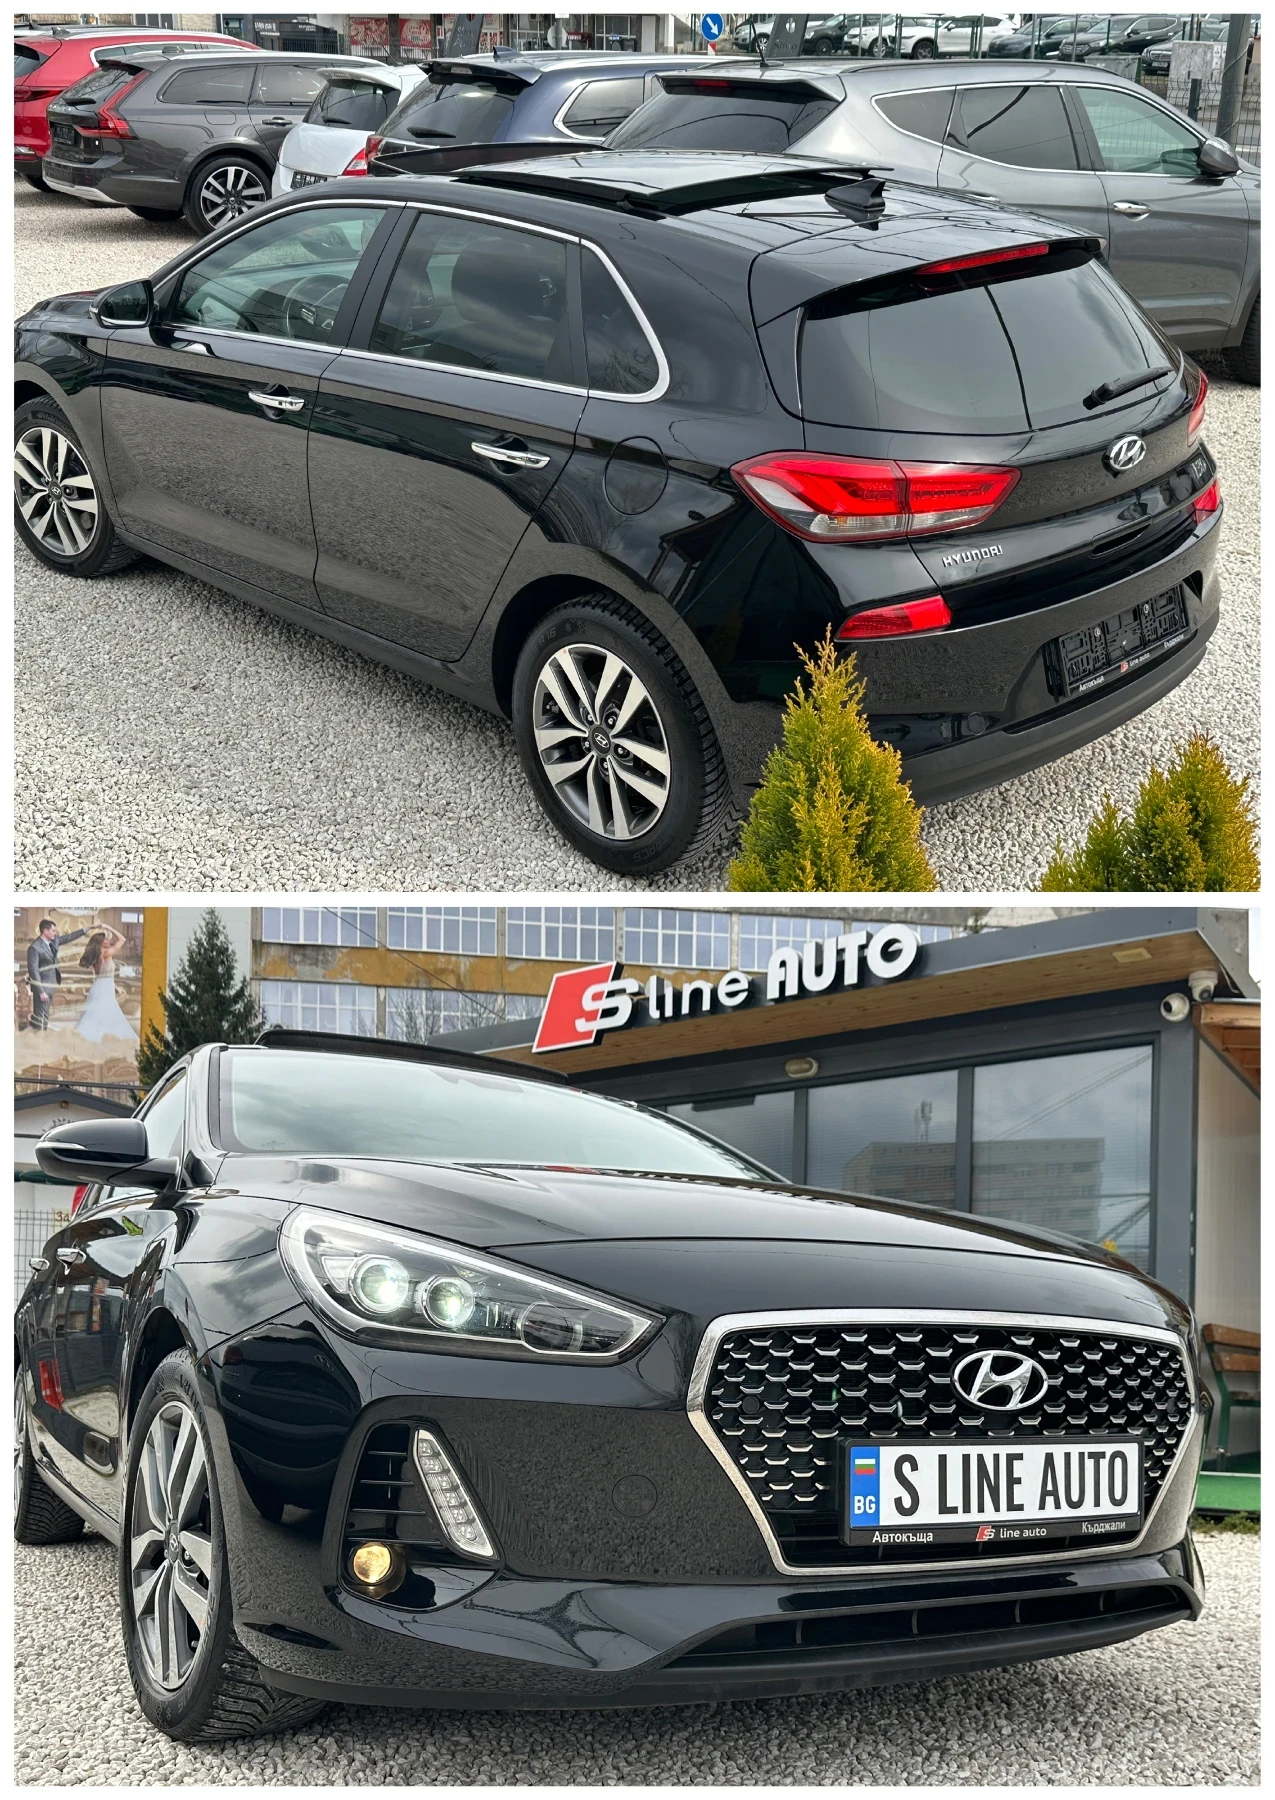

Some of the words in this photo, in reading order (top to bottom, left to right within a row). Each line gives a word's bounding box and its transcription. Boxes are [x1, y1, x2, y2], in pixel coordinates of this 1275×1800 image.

[942, 545, 1003, 567] HYUNDAI
[575, 978, 640, 1033] S
[648, 971, 750, 1020] line
[766, 923, 921, 1000] AUTO
[893, 1453, 920, 1517] S
[937, 1452, 1025, 1515] LINE
[1037, 1449, 1129, 1512] AUTO
[853, 1495, 876, 1515] BG
[999, 1526, 1020, 1540] line
[1022, 1526, 1047, 1538] auto
[1081, 1519, 1127, 1534] Кърджали
[872, 1530, 934, 1544] Автокъща
